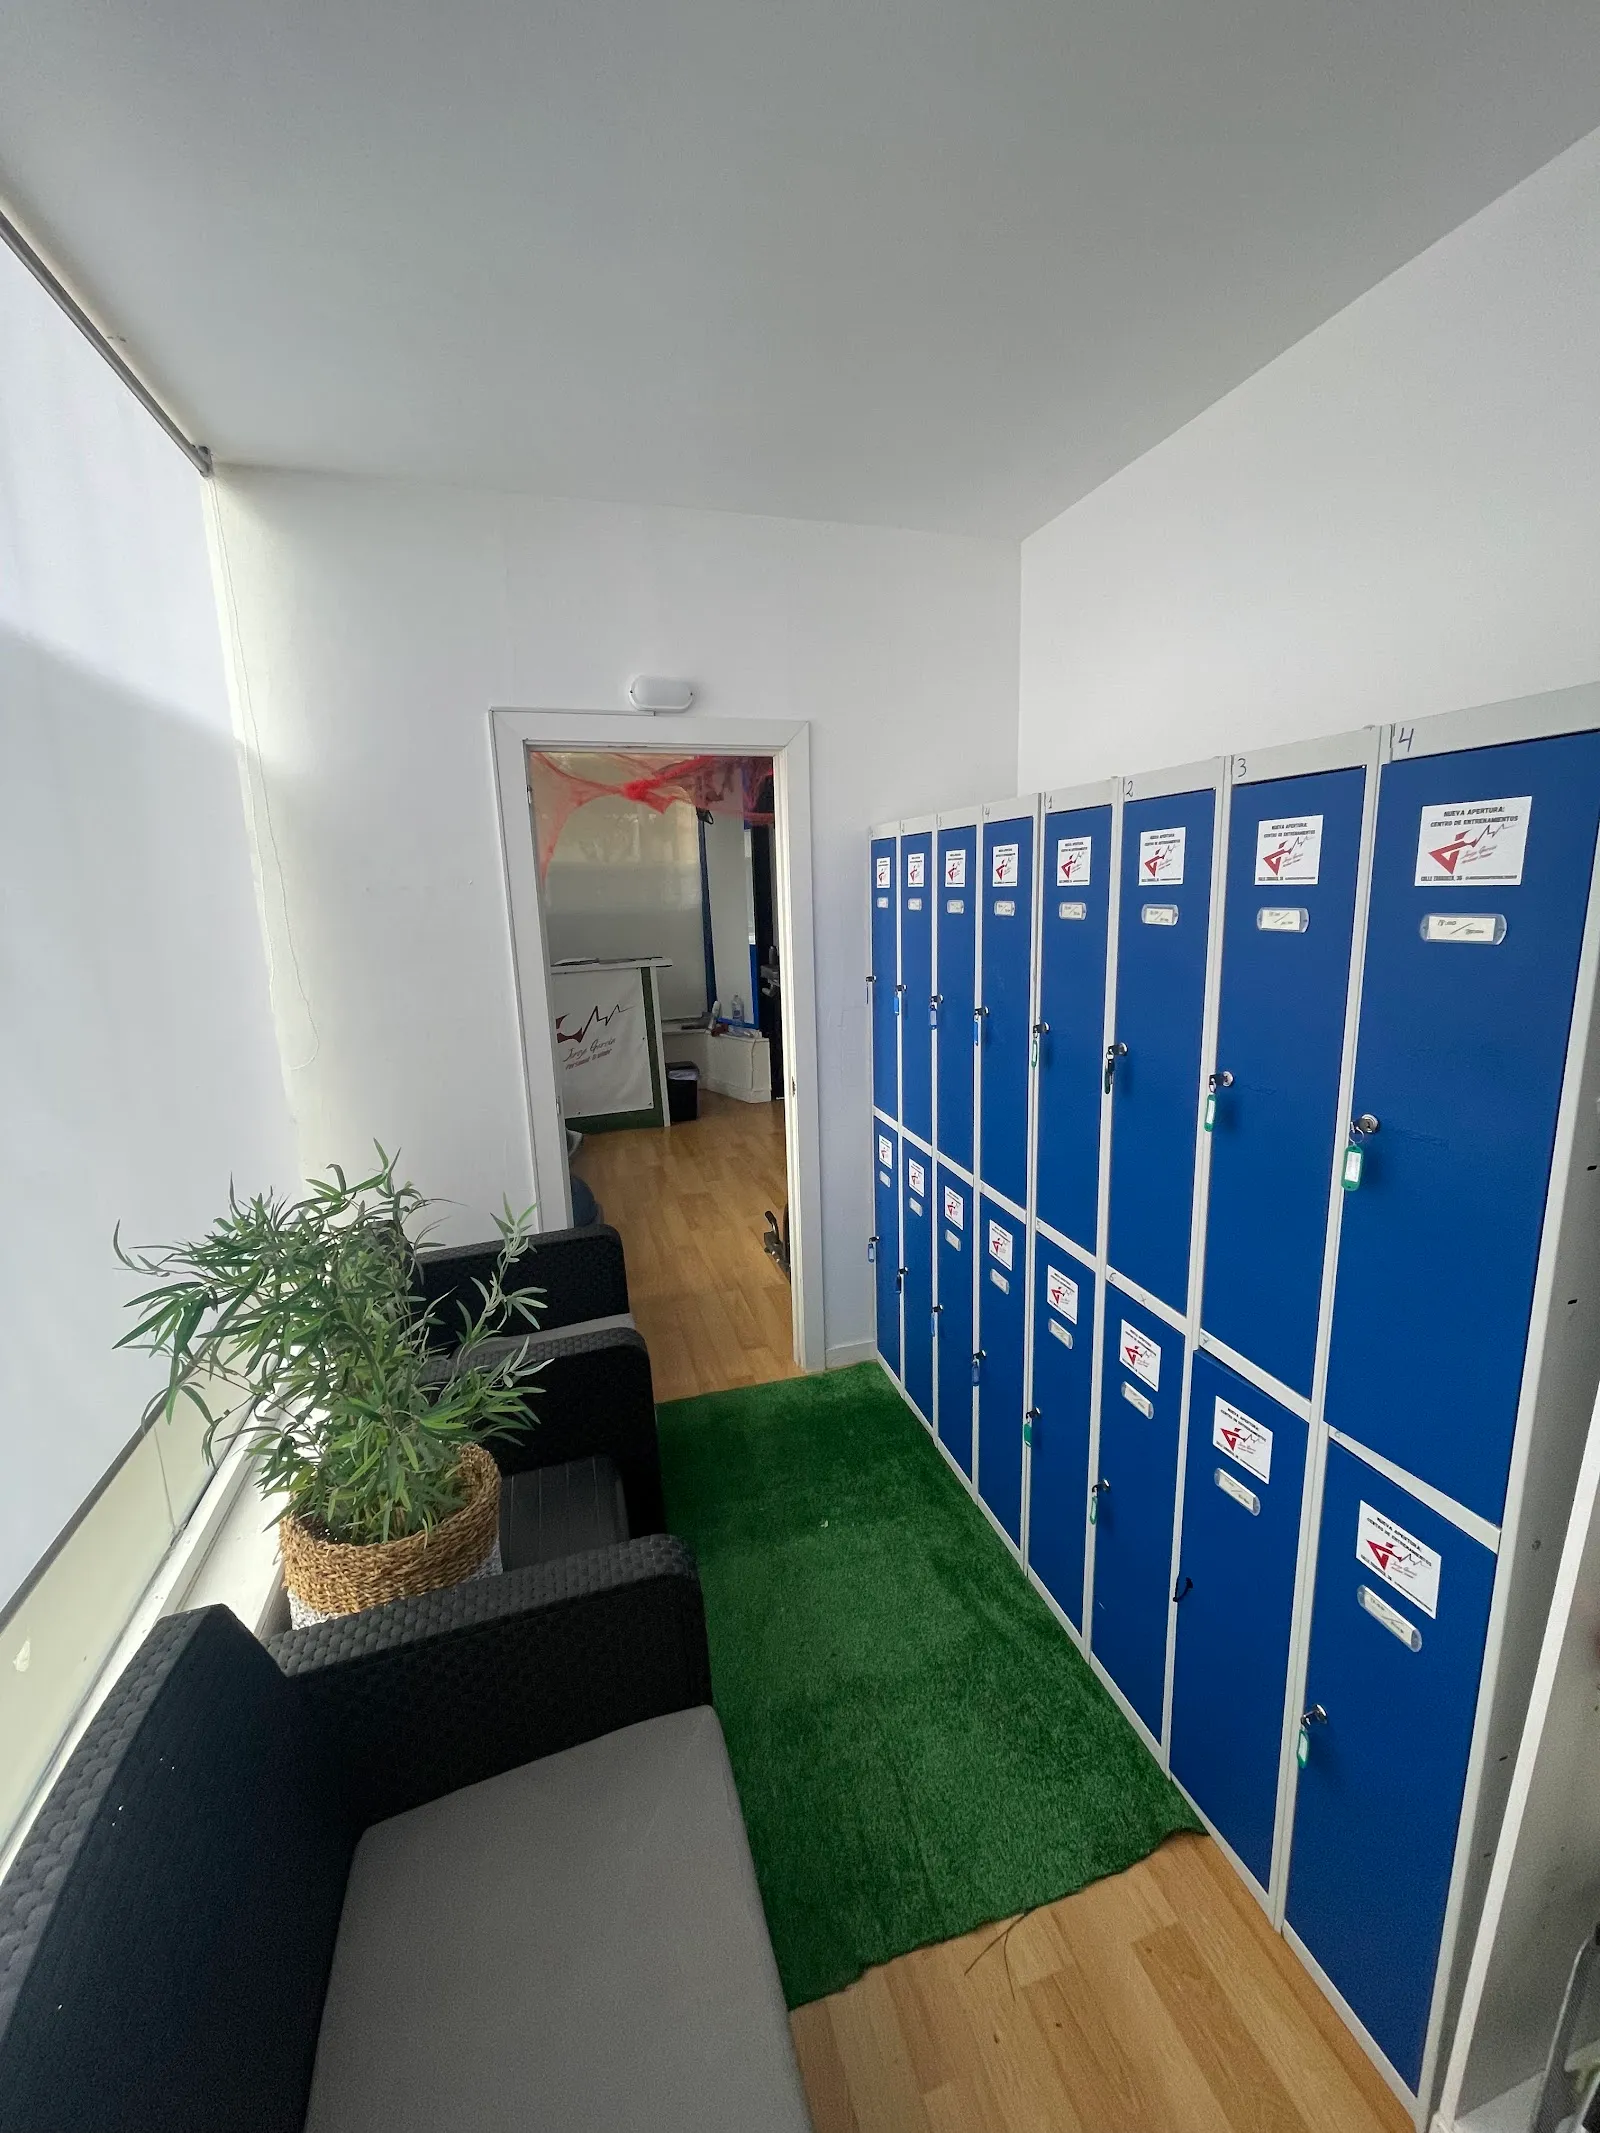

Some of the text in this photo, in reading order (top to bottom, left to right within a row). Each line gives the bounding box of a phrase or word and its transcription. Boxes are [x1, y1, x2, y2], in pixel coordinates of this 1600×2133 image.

[1398, 727, 1414, 752] 4
[1237, 757, 1247, 778] 3
[1125, 780, 1134, 798] 2
[1444, 806, 1505, 817] NUEVA APERTURA:
[1463, 816, 1518, 825] ENTRENAMIENTOS
[1108, 1272, 1117, 1282] 6
